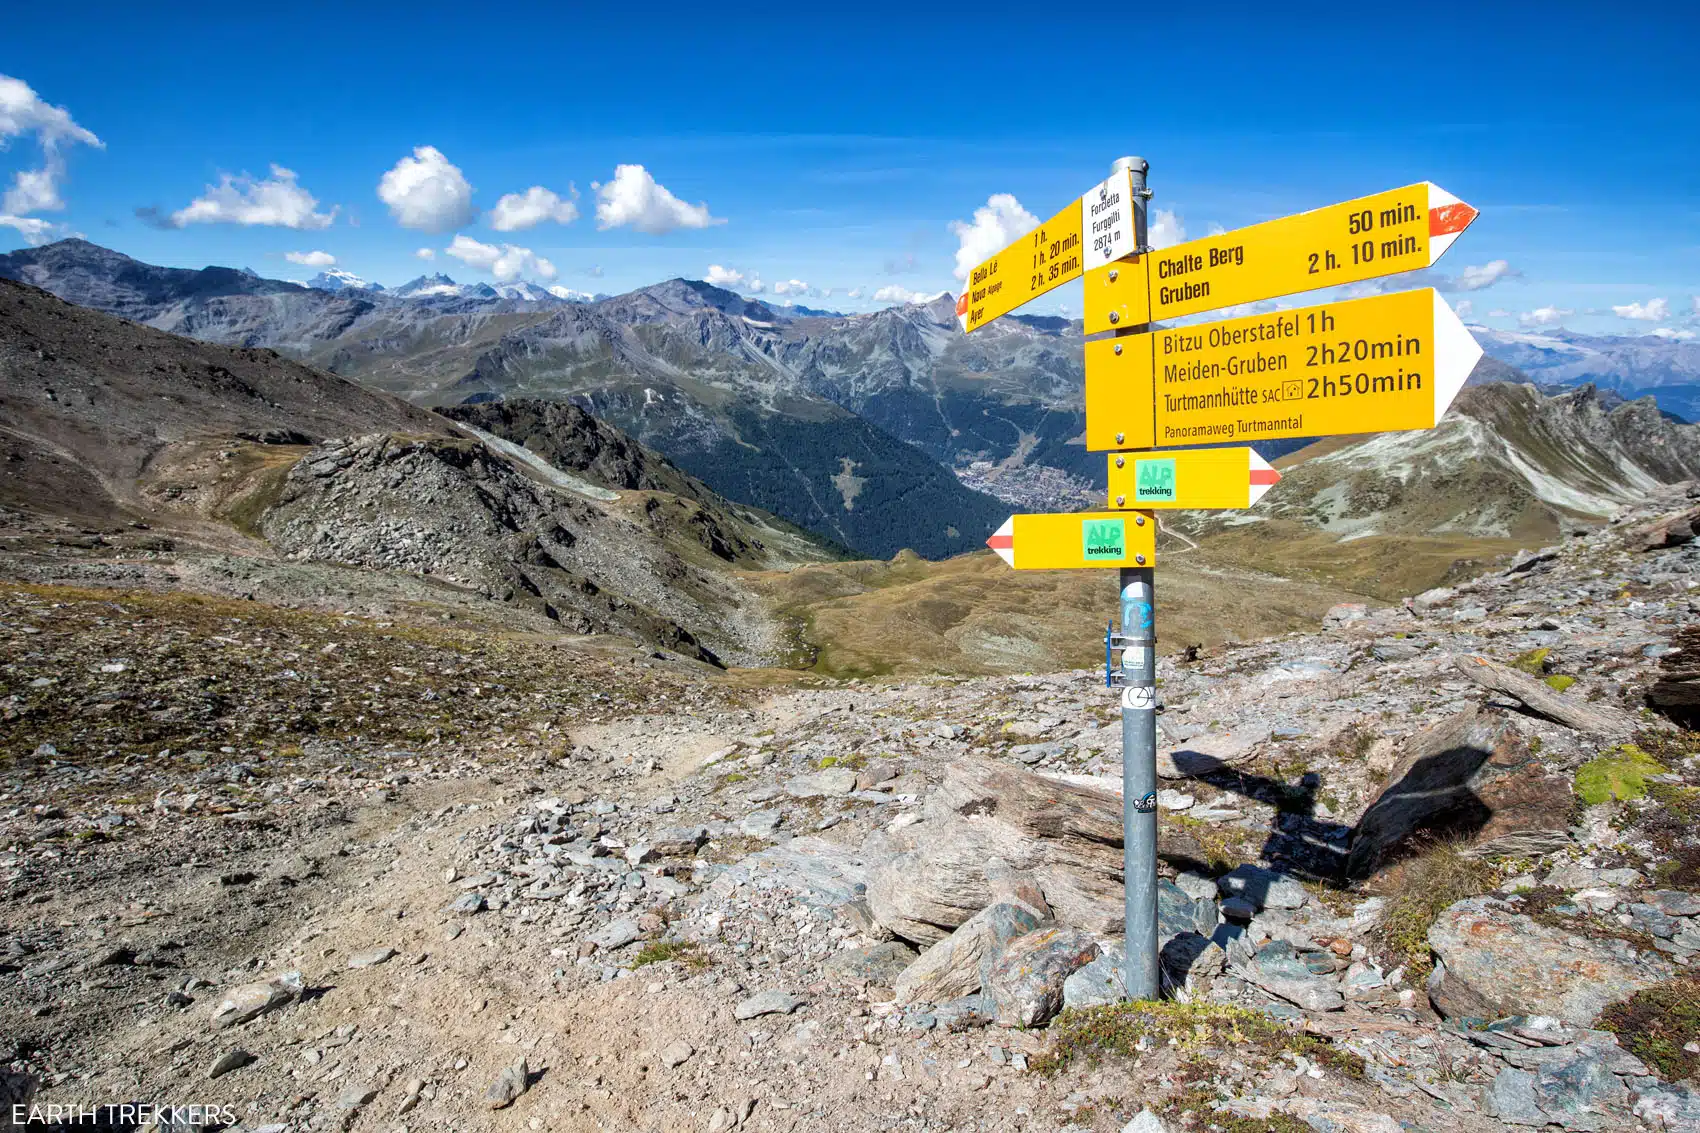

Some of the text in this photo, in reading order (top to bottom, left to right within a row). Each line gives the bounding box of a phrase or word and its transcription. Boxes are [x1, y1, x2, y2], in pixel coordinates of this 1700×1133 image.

[1091, 192, 1120, 217] Forcletta
[1092, 209, 1120, 234] Furggilti
[1094, 230, 1120, 251] 2874 m
[1159, 203, 1421, 279] Chalte Berg 50 min.
[972, 231, 1079, 304] Nava Alpage 1 h. 20 min.
[973, 267, 988, 285] Bella
[1035, 232, 1038, 248] 1
[1041, 230, 1047, 243] h.
[1160, 234, 1422, 305] Gruben 2 h. 10 min.
[970, 255, 1080, 324] Ayer 2 h. 35 min.
[1164, 310, 1335, 354] Bitzu Oberstafel 1h
[1164, 353, 1287, 384] Meiden-Gruben
[1165, 385, 1258, 412] Turtmannhütte
[1262, 388, 1281, 404] SAC
[1165, 415, 1303, 439] Panoramaweg Turtmanntal
[1140, 464, 1173, 486] ALP
[1139, 486, 1172, 497] trekking
[1087, 525, 1121, 545] ALP
[1087, 545, 1121, 556] trekking
